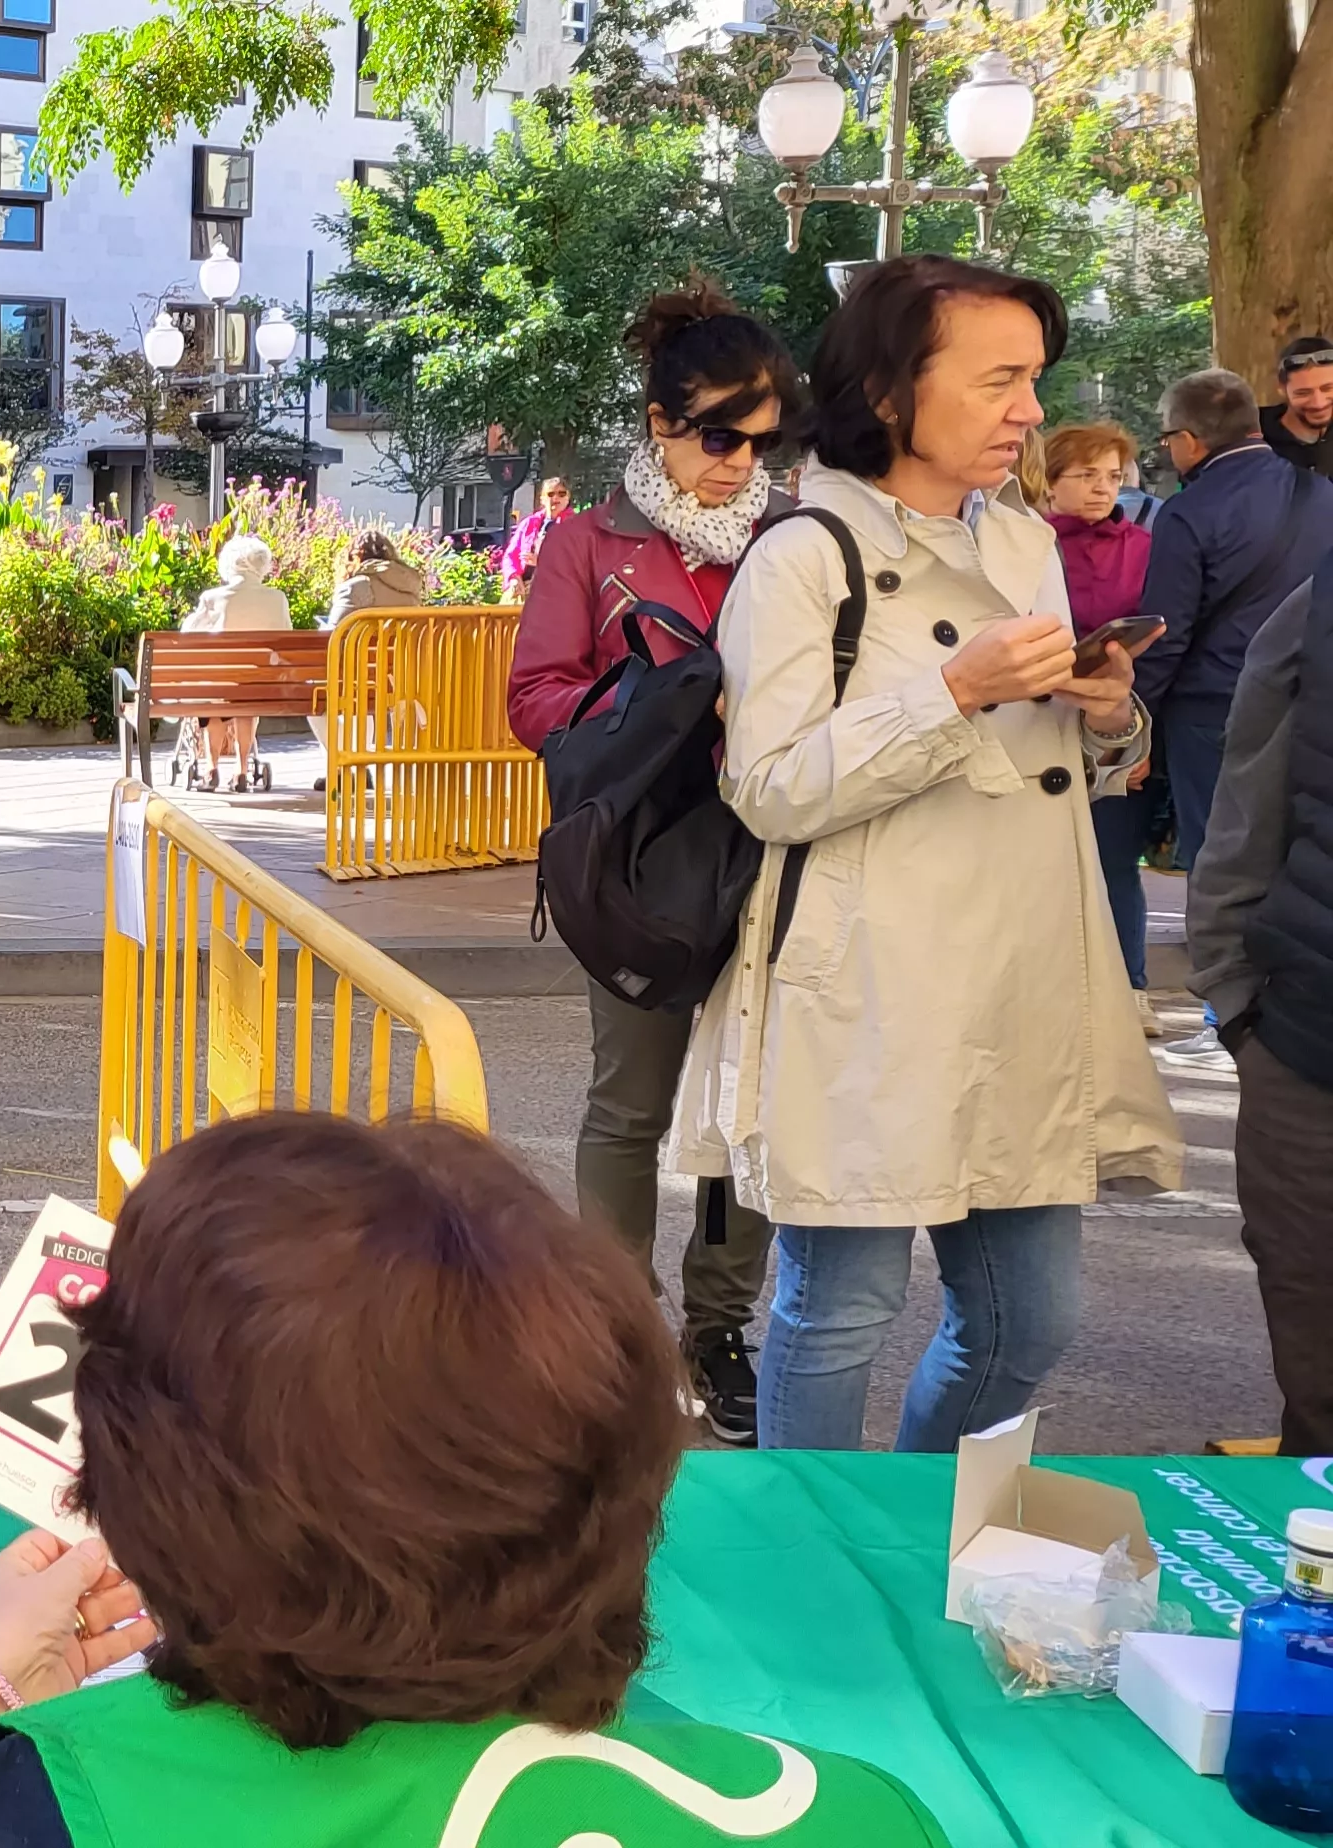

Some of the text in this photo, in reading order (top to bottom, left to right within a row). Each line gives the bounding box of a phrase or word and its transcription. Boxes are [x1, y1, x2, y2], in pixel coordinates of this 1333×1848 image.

[52, 1242, 106, 1268] IX EDICI
[1152, 1468, 1259, 1532] cáncer
